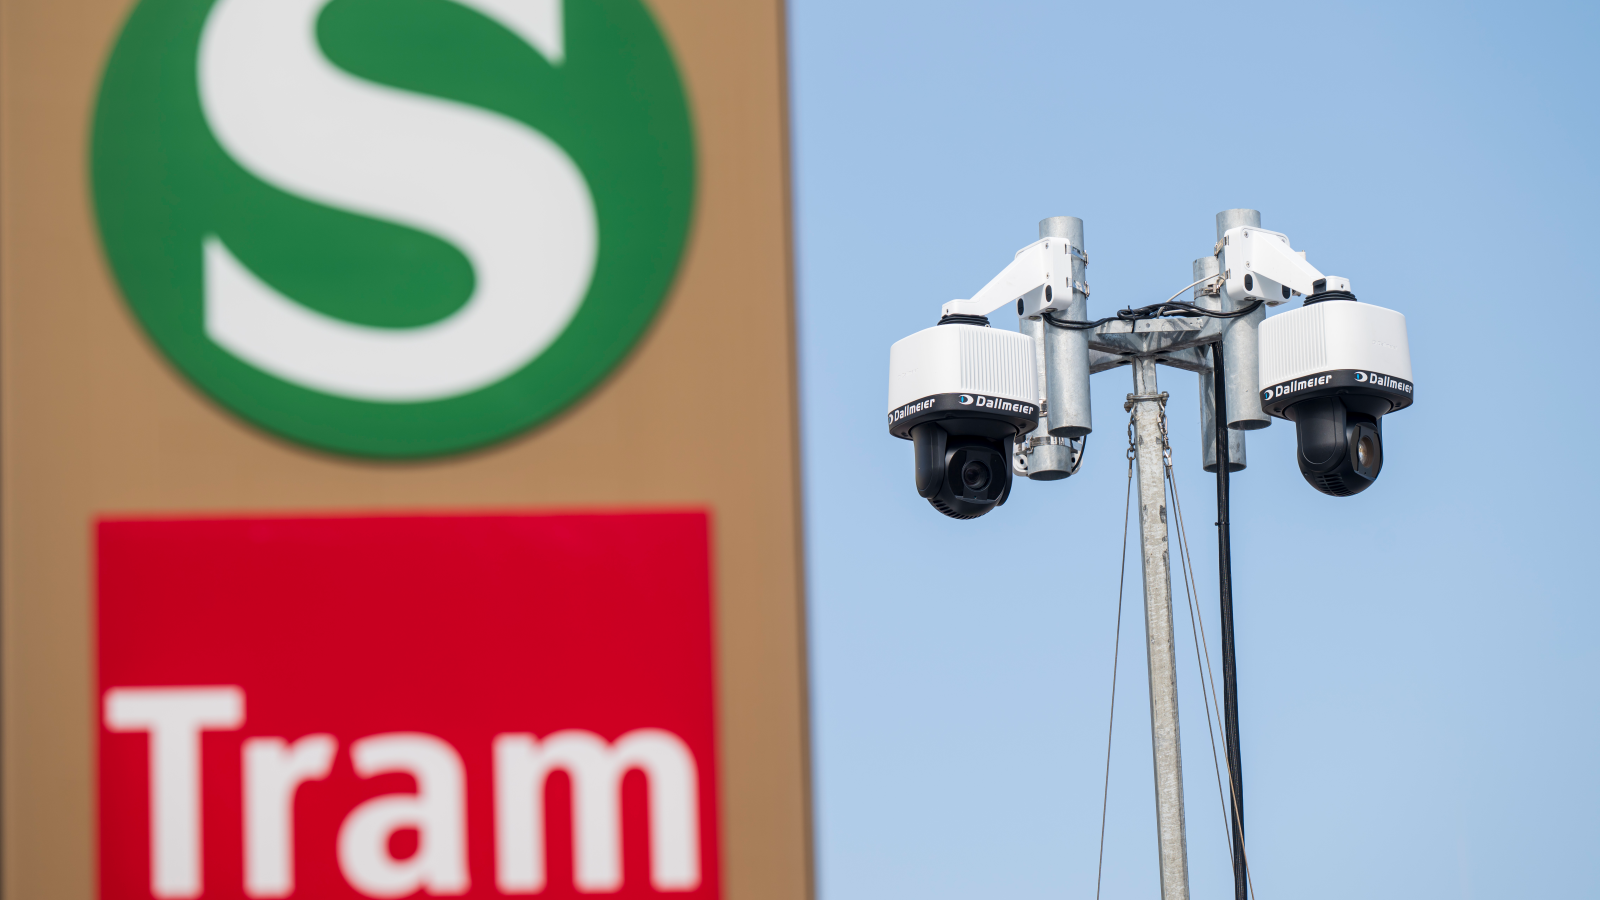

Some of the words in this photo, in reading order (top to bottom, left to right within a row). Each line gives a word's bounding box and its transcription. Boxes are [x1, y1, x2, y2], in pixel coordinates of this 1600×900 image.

[196, 0, 598, 403] S
[1275, 375, 1332, 398] Dallmeier
[1369, 372, 1413, 394] Dallmeier
[893, 398, 936, 422] Dallmeier
[976, 395, 1034, 415] Dallmeier
[103, 685, 702, 899] Tram
